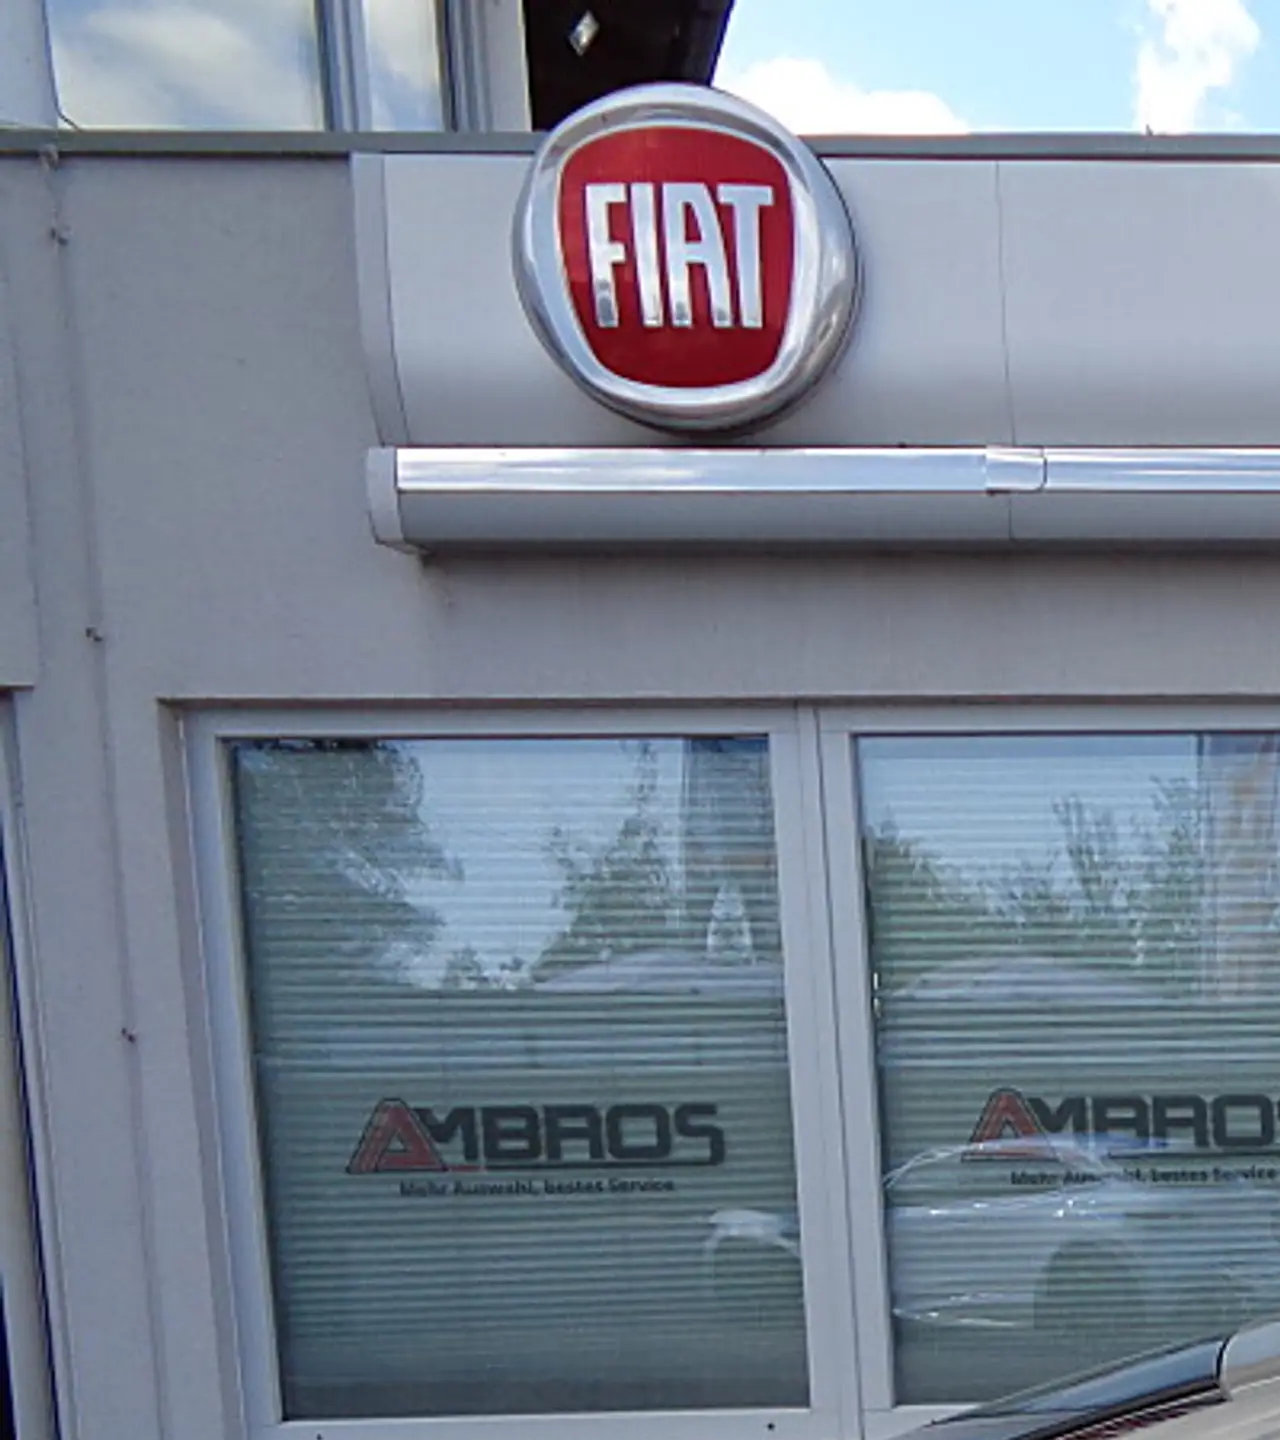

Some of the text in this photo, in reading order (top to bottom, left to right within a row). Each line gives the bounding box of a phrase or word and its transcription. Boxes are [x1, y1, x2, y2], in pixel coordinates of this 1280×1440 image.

[585, 182, 774, 328] FIAT
[346, 1098, 725, 1174] AMBROS
[400, 1178, 447, 1197] Mehr
[608, 1176, 675, 1192] Service
